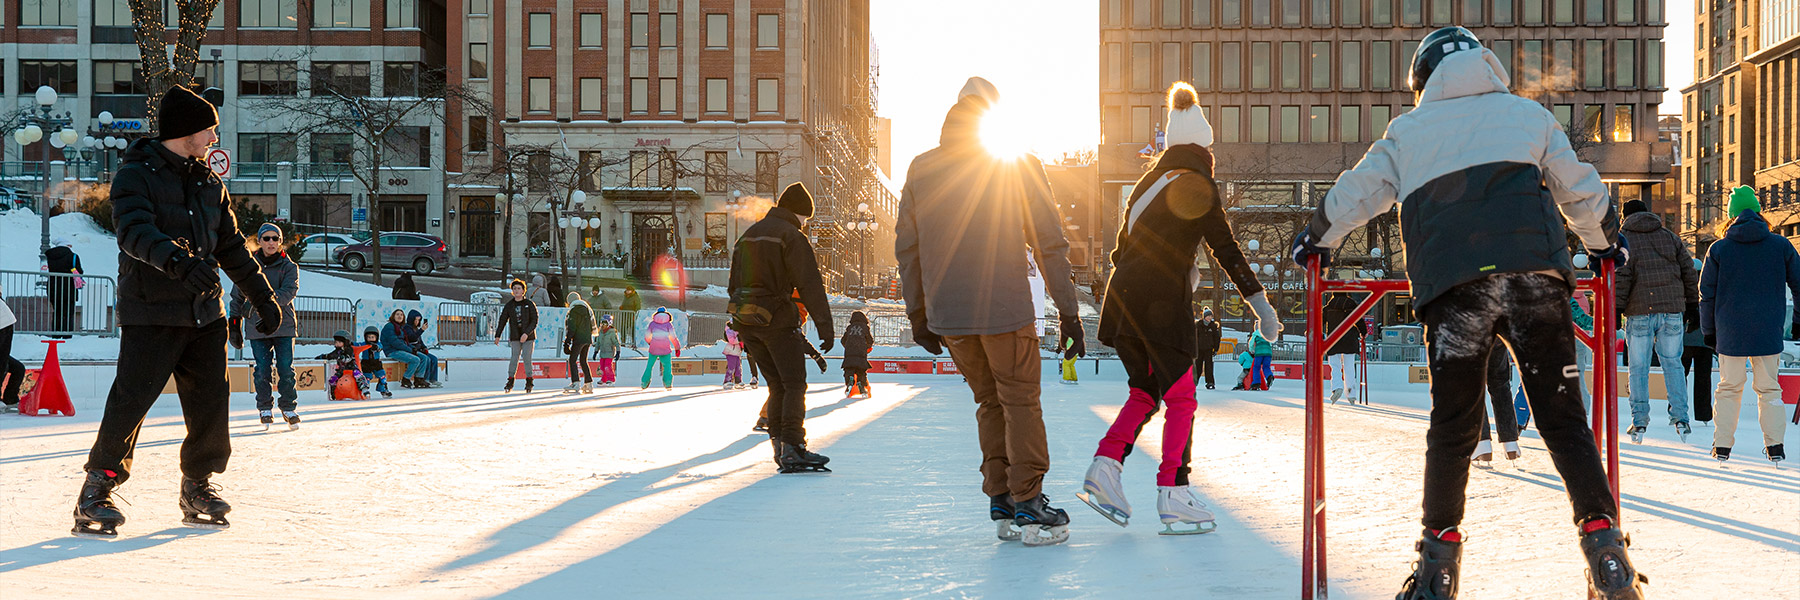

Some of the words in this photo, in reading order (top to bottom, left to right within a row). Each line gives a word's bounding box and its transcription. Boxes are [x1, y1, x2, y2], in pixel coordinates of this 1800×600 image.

[98, 120, 142, 129] OVO
[634, 138, 671, 147] Marriott
[388, 178, 409, 186] 900
[1281, 280, 1304, 290] CAFÉ
